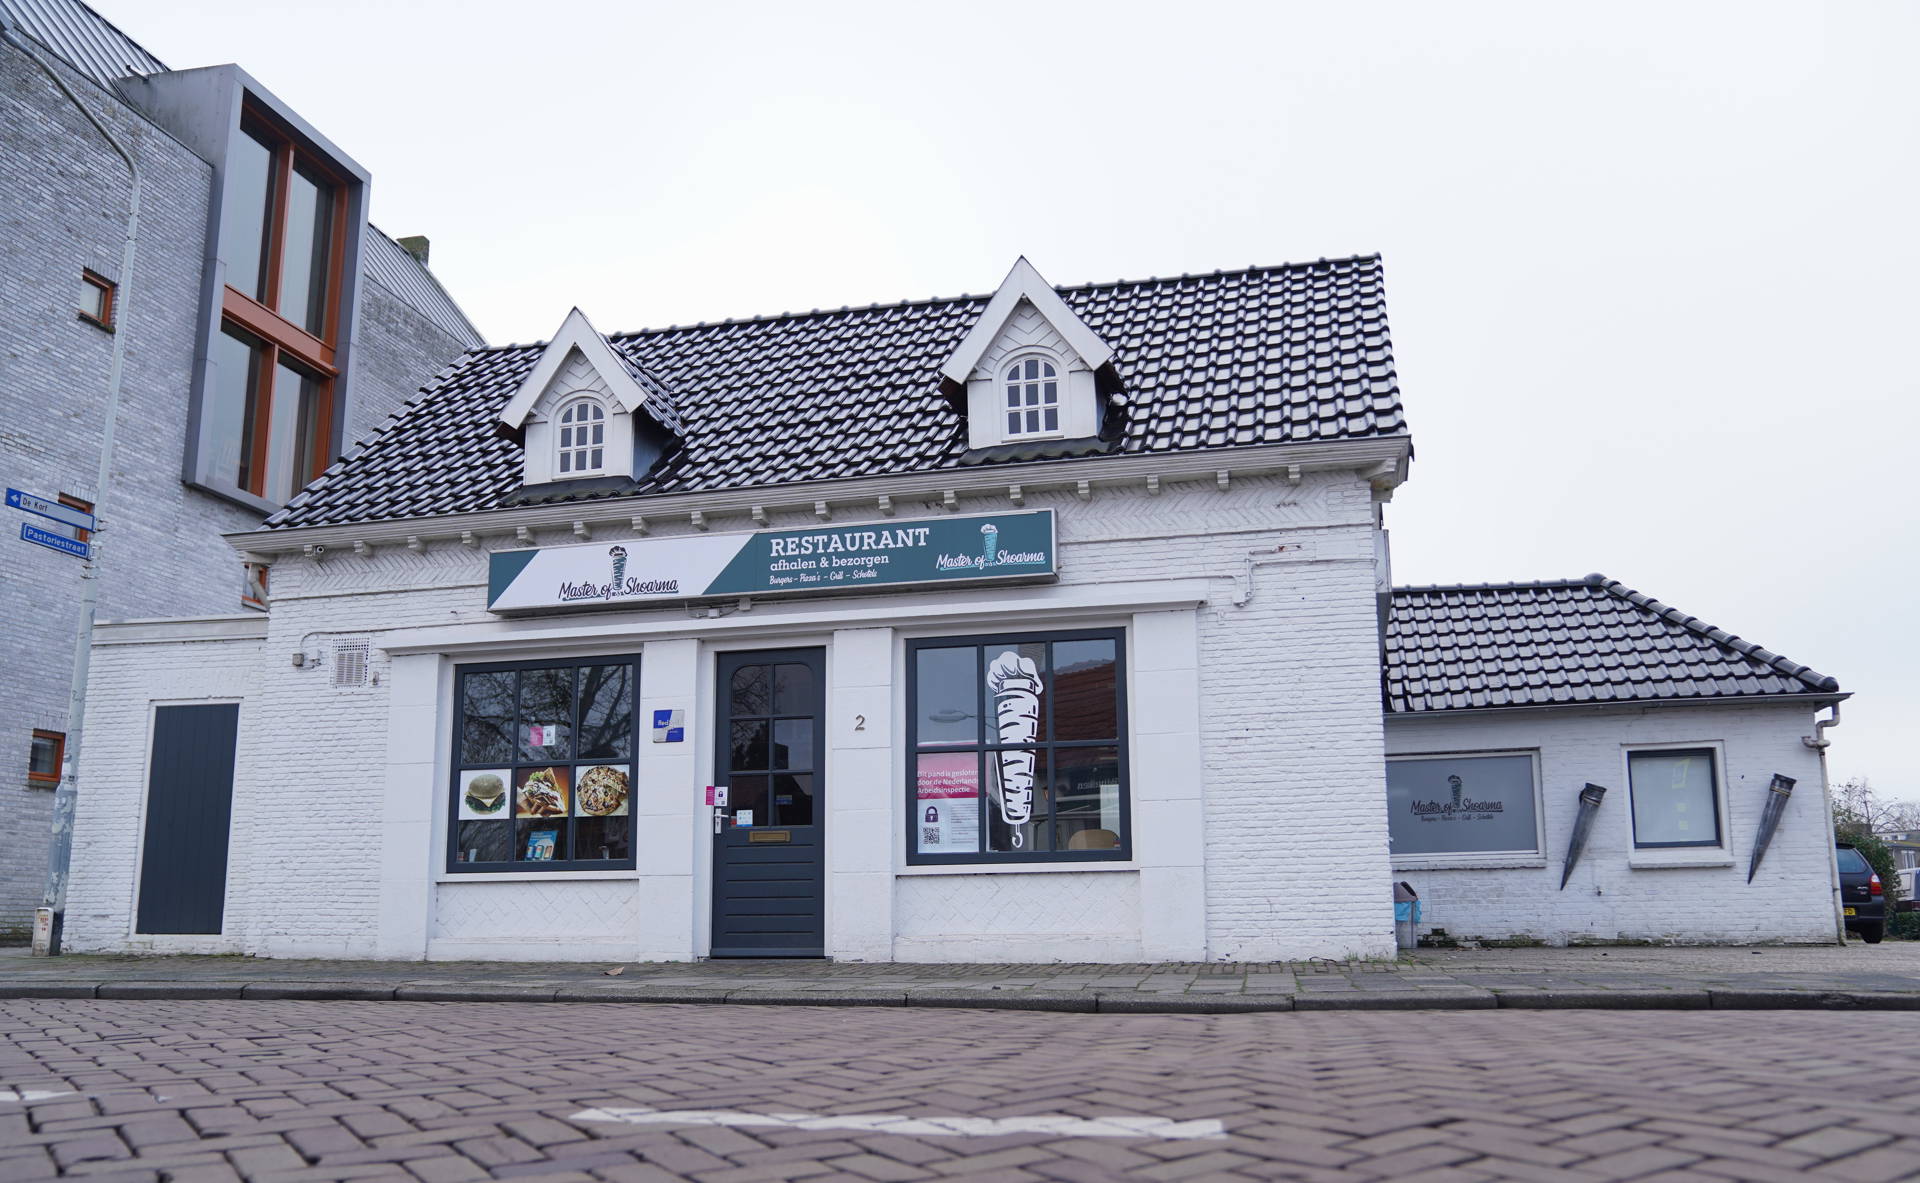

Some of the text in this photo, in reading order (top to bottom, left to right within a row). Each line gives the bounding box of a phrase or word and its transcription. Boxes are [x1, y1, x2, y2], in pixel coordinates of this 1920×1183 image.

[22, 497, 32, 507] De
[27, 529, 85, 553] Pastoriestraat
[770, 528, 929, 557] RESTAURANT
[770, 554, 889, 572] afhalen & bezorgen
[936, 550, 1045, 570] Master of Shoarma
[558, 577, 679, 600] Master of Shoarma
[769, 575, 793, 586] Burgers
[854, 714, 865, 731] 2
[1410, 798, 1503, 816] Master of Shoarma
